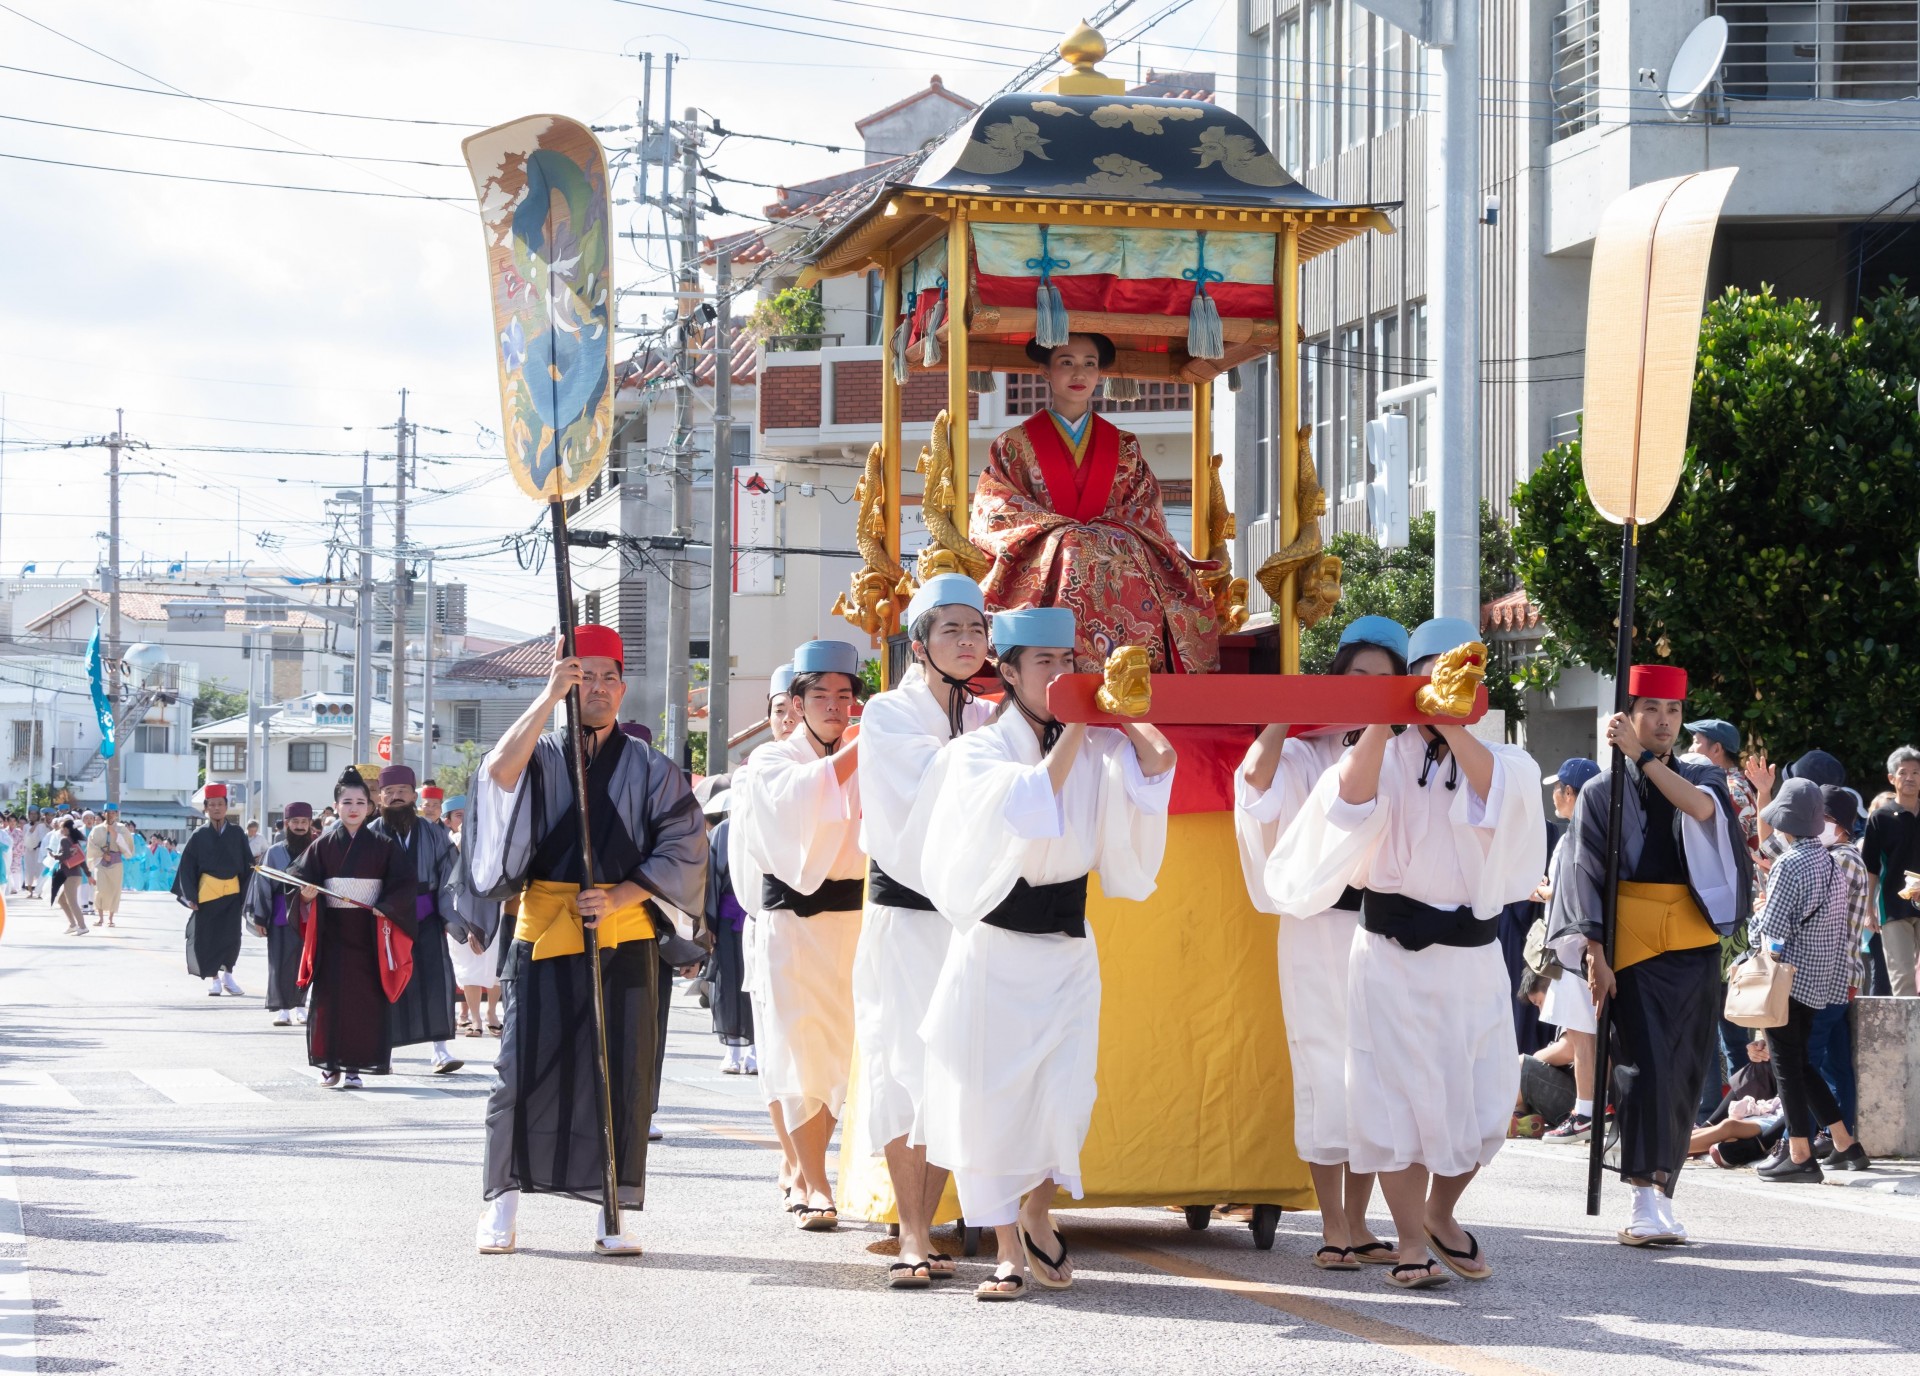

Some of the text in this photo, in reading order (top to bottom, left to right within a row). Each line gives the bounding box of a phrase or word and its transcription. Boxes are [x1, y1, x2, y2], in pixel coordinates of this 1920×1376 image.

[750, 500, 759, 587] ヒューマンポート
